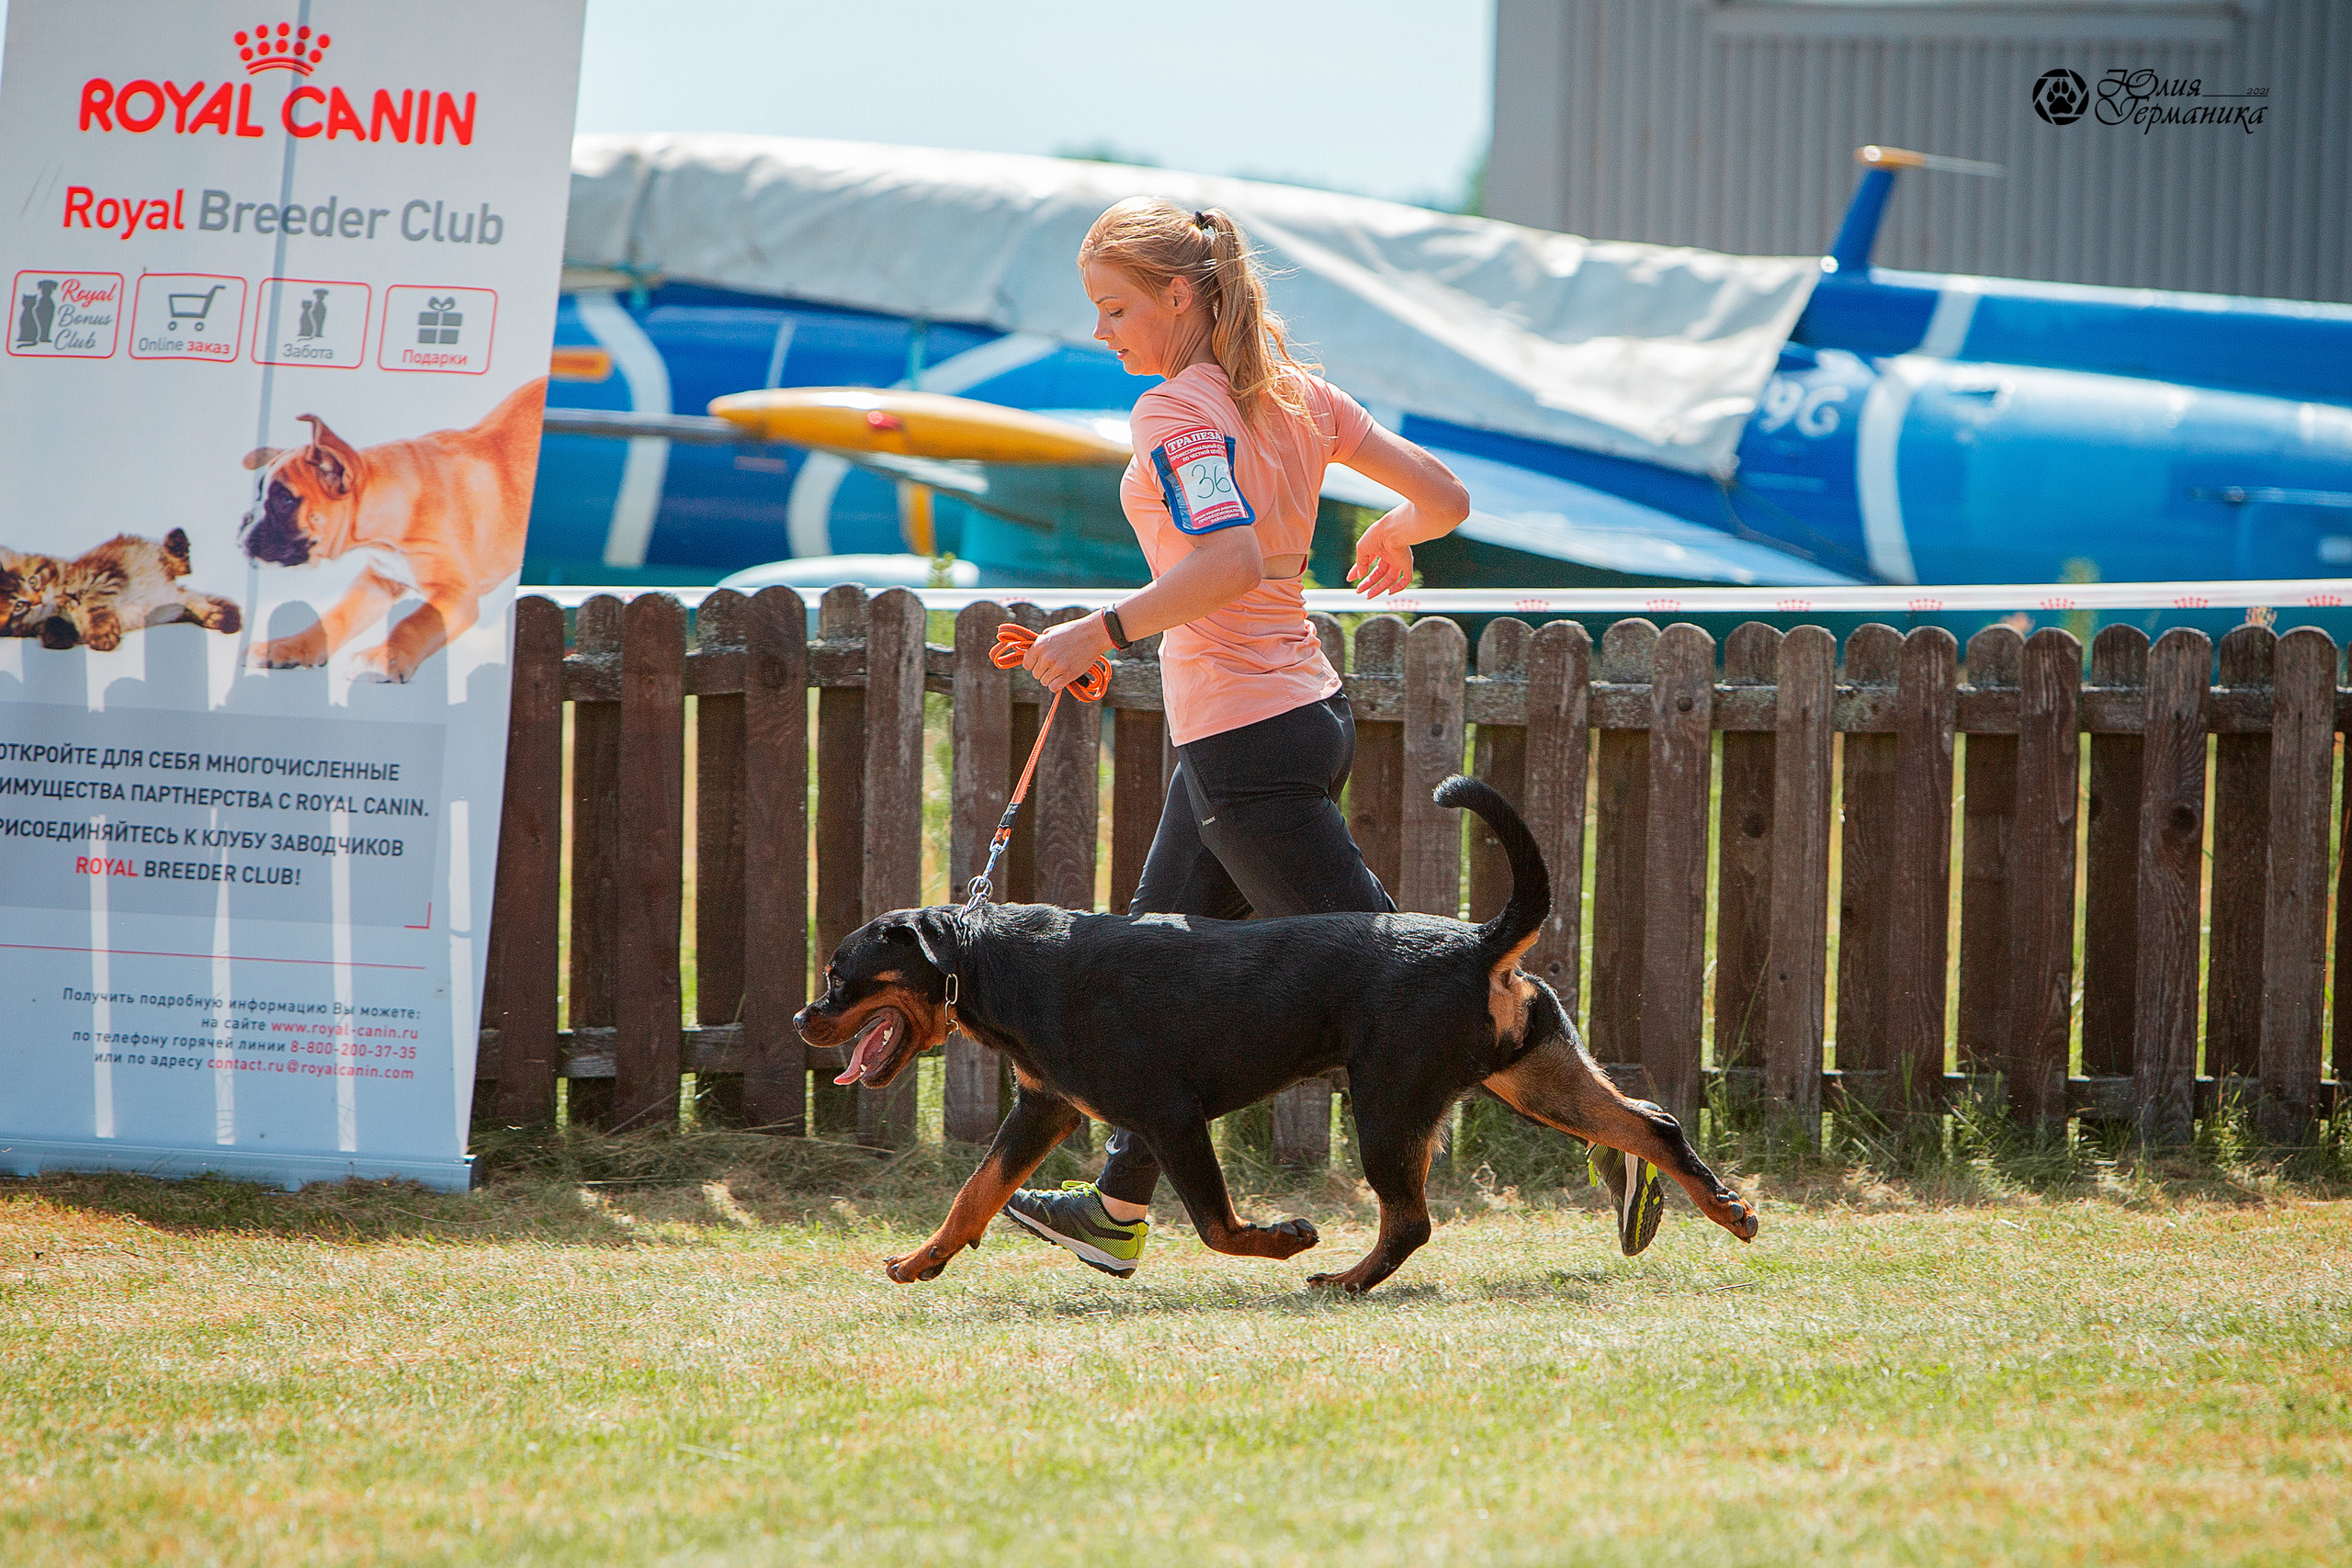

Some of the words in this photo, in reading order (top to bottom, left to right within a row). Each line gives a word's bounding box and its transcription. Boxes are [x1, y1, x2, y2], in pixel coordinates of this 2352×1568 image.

[79, 78, 264, 137] ROYAL
[281, 85, 476, 146] CANIN
[62, 186, 186, 240] Royal
[198, 188, 389, 239] Breeder
[401, 199, 504, 245] Club
[61, 278, 117, 308] Royal
[57, 304, 112, 327] Bonus
[54, 328, 96, 350] Club
[138, 337, 184, 353] Online
[187, 341, 230, 355] заказ
[283, 344, 334, 359] Забота
[402, 349, 468, 366] Подарки
[1168, 432, 1222, 451] ТРАПЕЗА
[1192, 464, 1232, 499] 36
[0, 742, 97, 764] ОТКРОЙТЕ
[100, 749, 143, 769] ДЛЯ
[149, 750, 200, 771] СЕБЯ
[206, 753, 400, 781] МНОГОЧИСЛЕННЫЕ
[130, 784, 273, 808] ПАРТНЕРСТВА
[278, 792, 291, 809] С
[296, 793, 358, 813] ROYAL
[364, 796, 429, 817] CANIN.
[184, 829, 198, 845] К
[201, 829, 267, 849] КЛУБУ
[270, 833, 403, 856] ЗАВОДЧИКОВ
[75, 856, 139, 877] ROYAL
[144, 860, 237, 882] BREEDER
[242, 865, 301, 886] CLUB!
[62, 987, 134, 1004] Получить
[140, 994, 223, 1010] подробную
[229, 998, 327, 1016] информацию
[333, 1002, 354, 1015] Вы
[360, 1007, 421, 1020] можете:
[201, 1019, 218, 1028] на
[224, 1017, 266, 1031] сайте
[270, 1021, 419, 1040] www.royal-canin.ru
[72, 1031, 90, 1042] по
[96, 1032, 168, 1048] телефону
[173, 1035, 233, 1050] горячей
[238, 1039, 286, 1052] линии
[290, 1040, 416, 1060] 8-800-200-37-35
[94, 1052, 122, 1064] или
[128, 1054, 145, 1065] по
[150, 1055, 202, 1070] адресу
[207, 1058, 414, 1079] contact.ru@royalcanin.com
